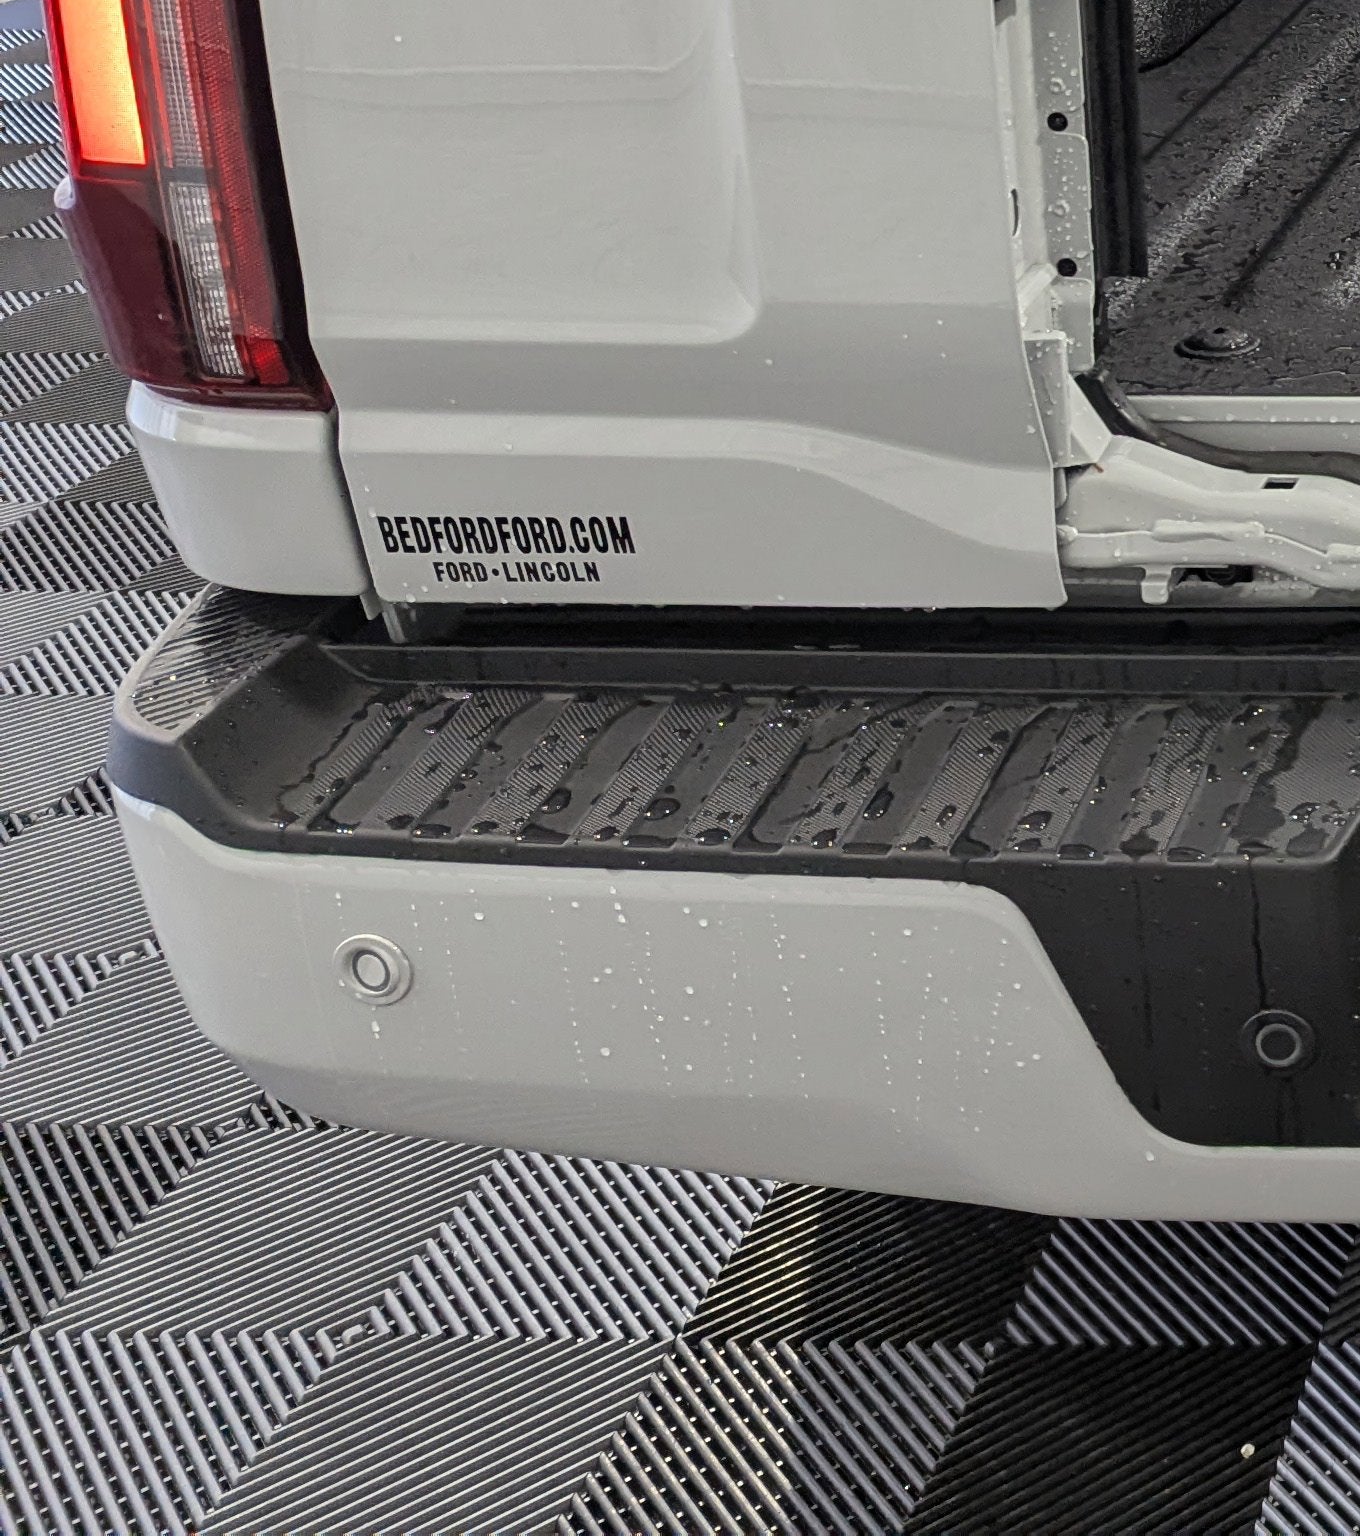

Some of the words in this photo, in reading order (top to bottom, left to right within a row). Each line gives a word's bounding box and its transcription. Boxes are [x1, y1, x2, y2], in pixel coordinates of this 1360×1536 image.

[376, 515, 637, 555] BEDFORDFORD.COM
[431, 561, 489, 583] FORD
[501, 561, 601, 583] LINCOLN
